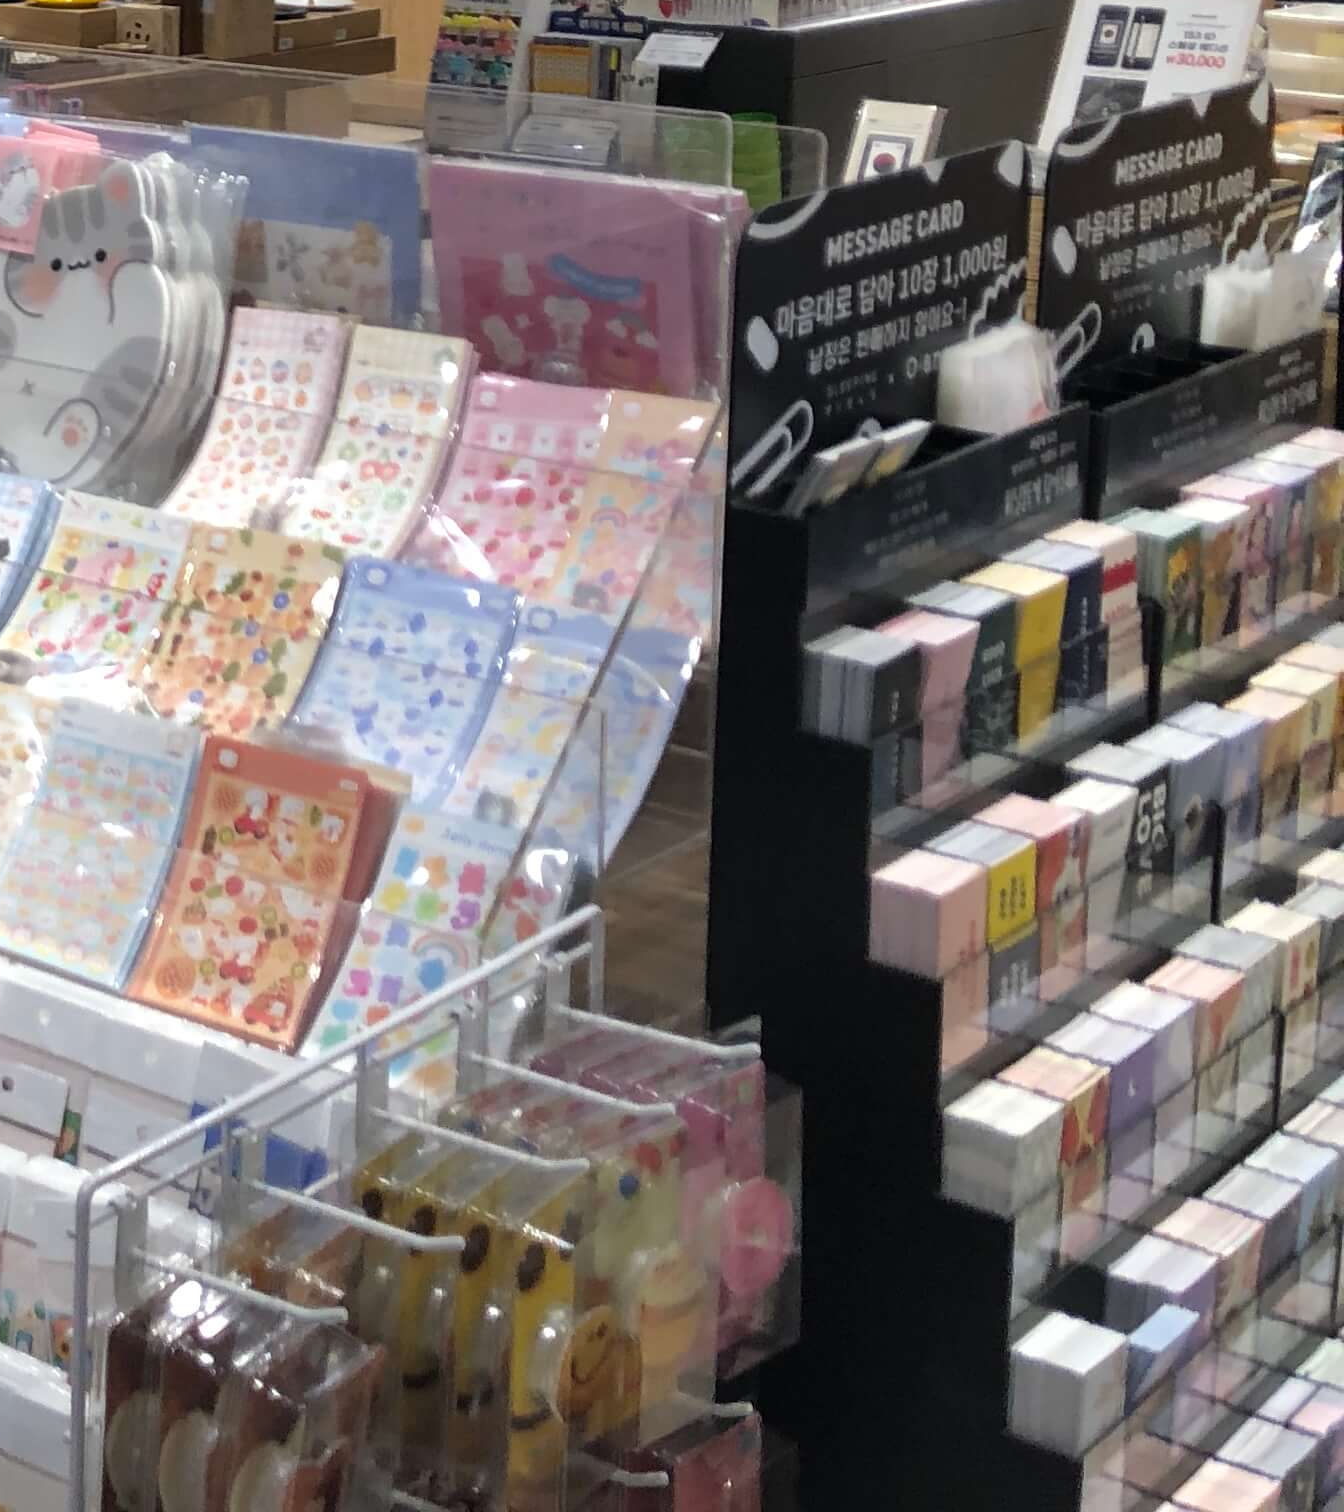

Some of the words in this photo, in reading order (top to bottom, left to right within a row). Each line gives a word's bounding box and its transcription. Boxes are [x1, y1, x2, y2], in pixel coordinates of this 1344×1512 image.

[1116, 142, 1184, 185] MESSAGE
[1186, 132, 1223, 166] CARD
[824, 213, 913, 267] MESSAGE
[916, 199, 965, 238] CARD
[1076, 203, 1135, 248] 마음대로
[775, 283, 853, 339] 마음대로
[859, 268, 896, 316] 담아
[898, 255, 940, 300] 10장
[941, 234, 1009, 289] 1,000원
